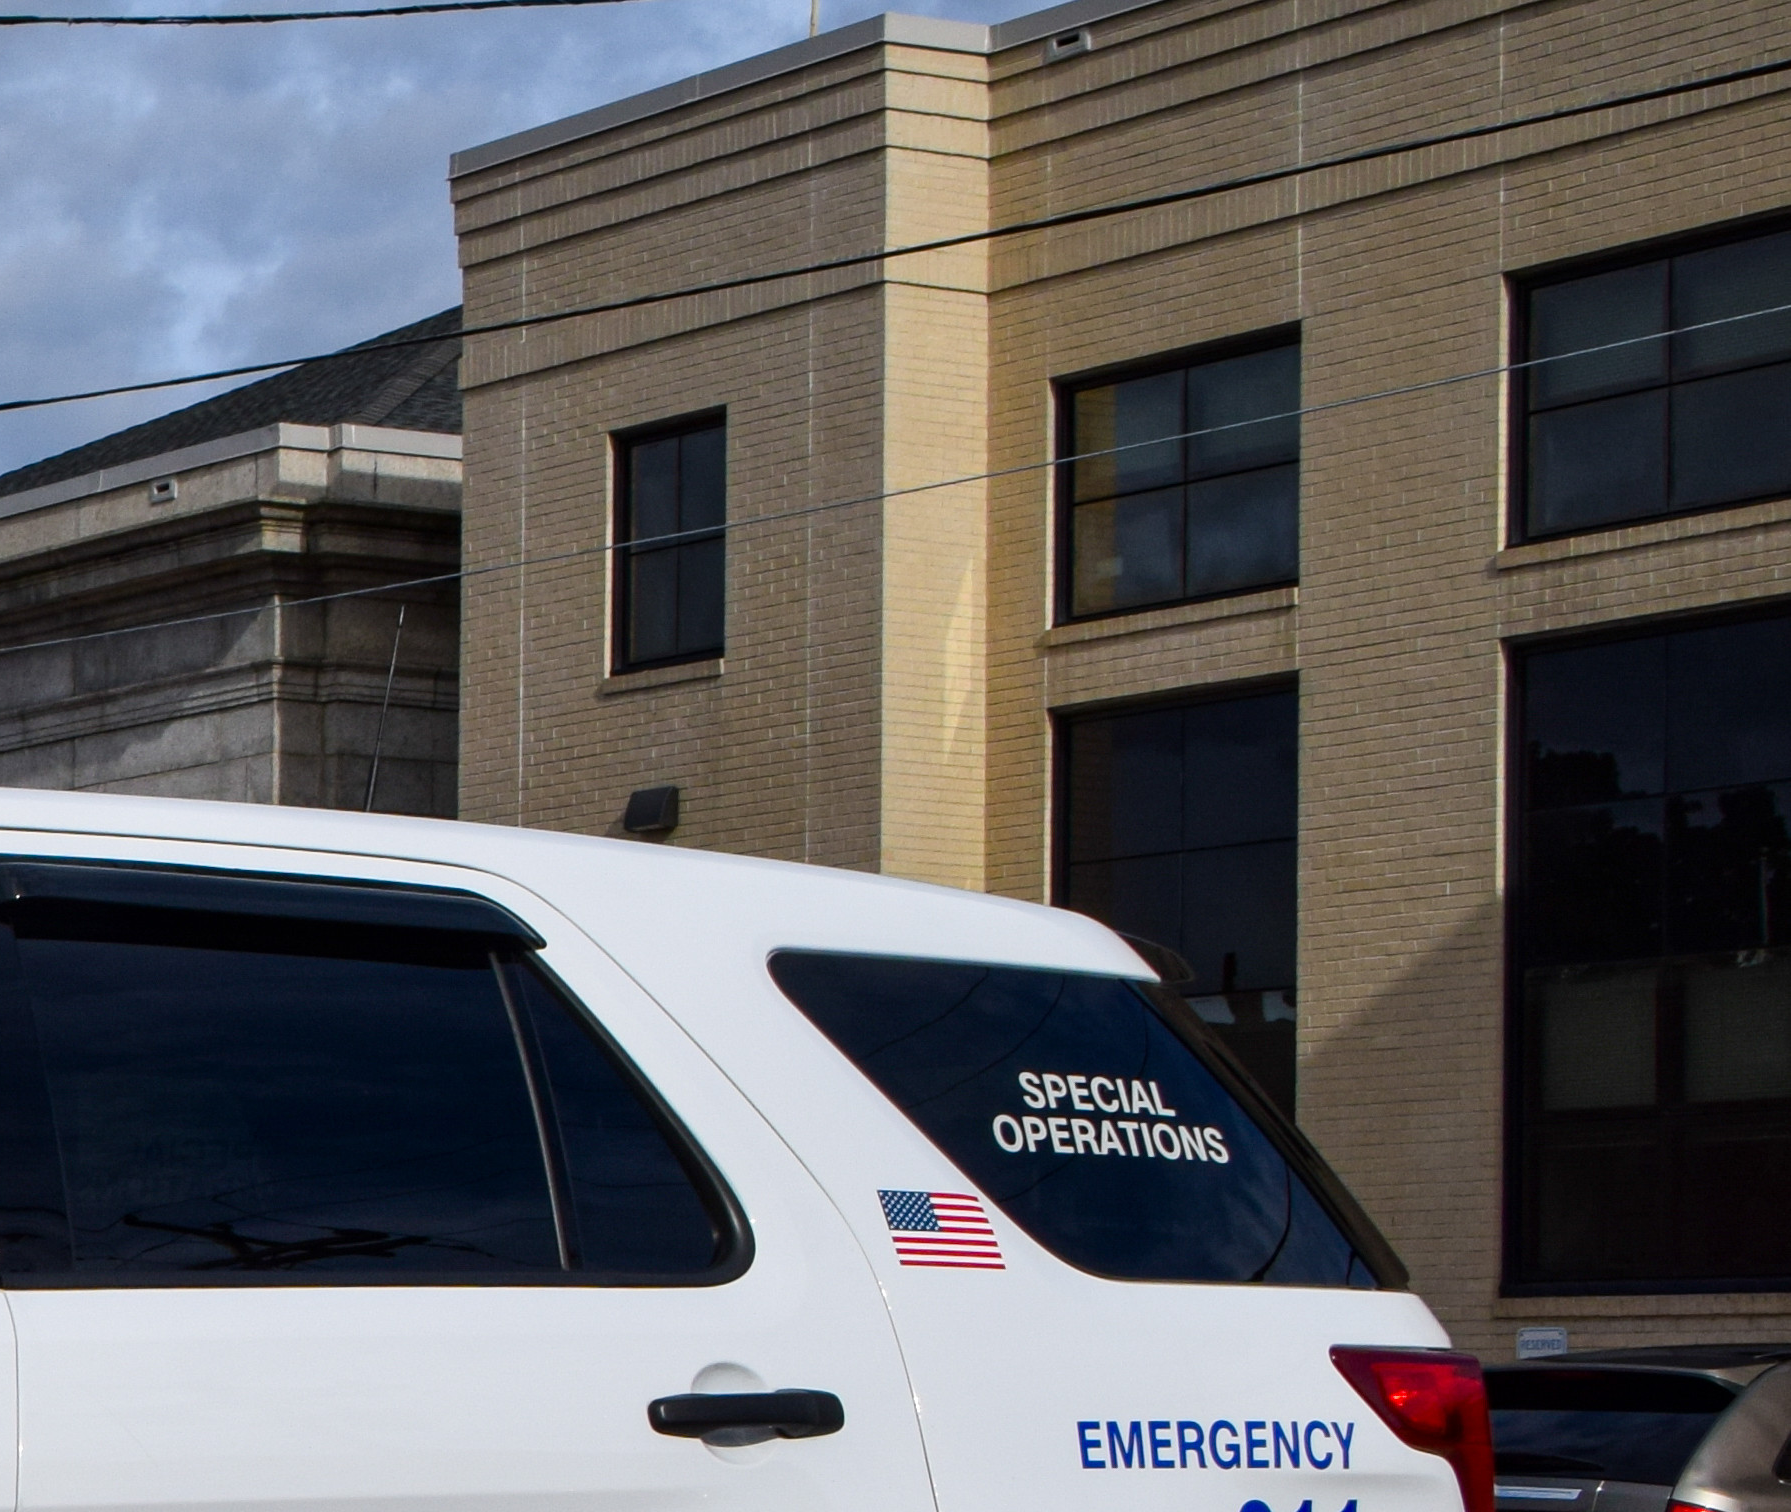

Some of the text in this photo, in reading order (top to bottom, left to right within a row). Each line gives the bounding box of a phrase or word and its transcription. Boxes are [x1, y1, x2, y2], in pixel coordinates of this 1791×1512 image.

[1018, 1071, 1176, 1117] SPECIAL
[992, 1114, 1229, 1164] OPERATIONS
[1077, 1419, 1355, 1470] EMERGENCY
